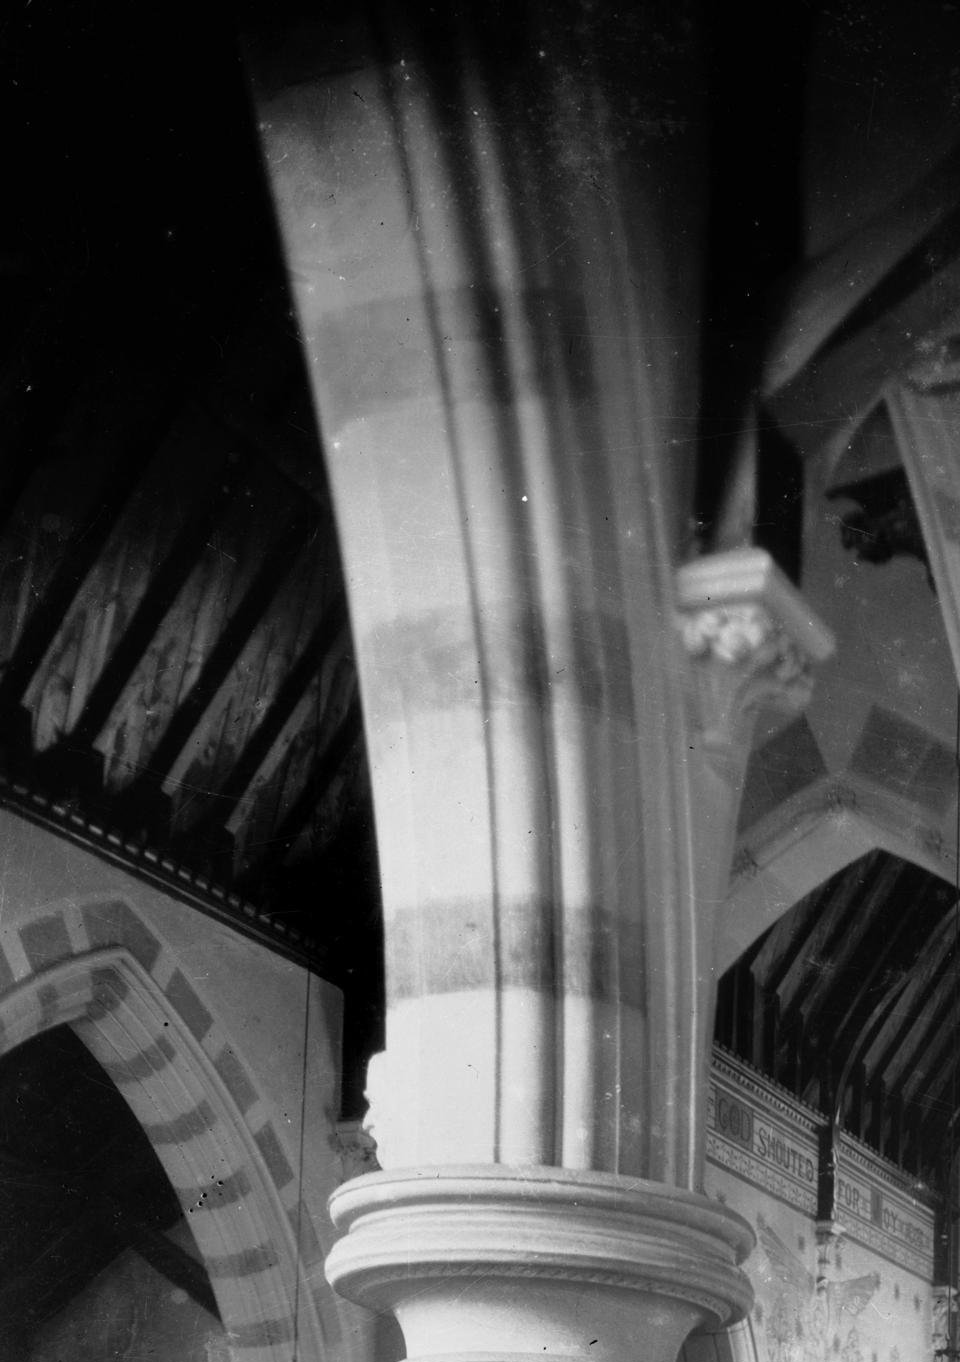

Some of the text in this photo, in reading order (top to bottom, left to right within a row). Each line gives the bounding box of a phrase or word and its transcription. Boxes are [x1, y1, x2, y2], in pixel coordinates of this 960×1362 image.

[718, 1097, 752, 1142] GOD
[758, 1127, 815, 1183] SHOUTED
[837, 1178, 860, 1216] FOR
